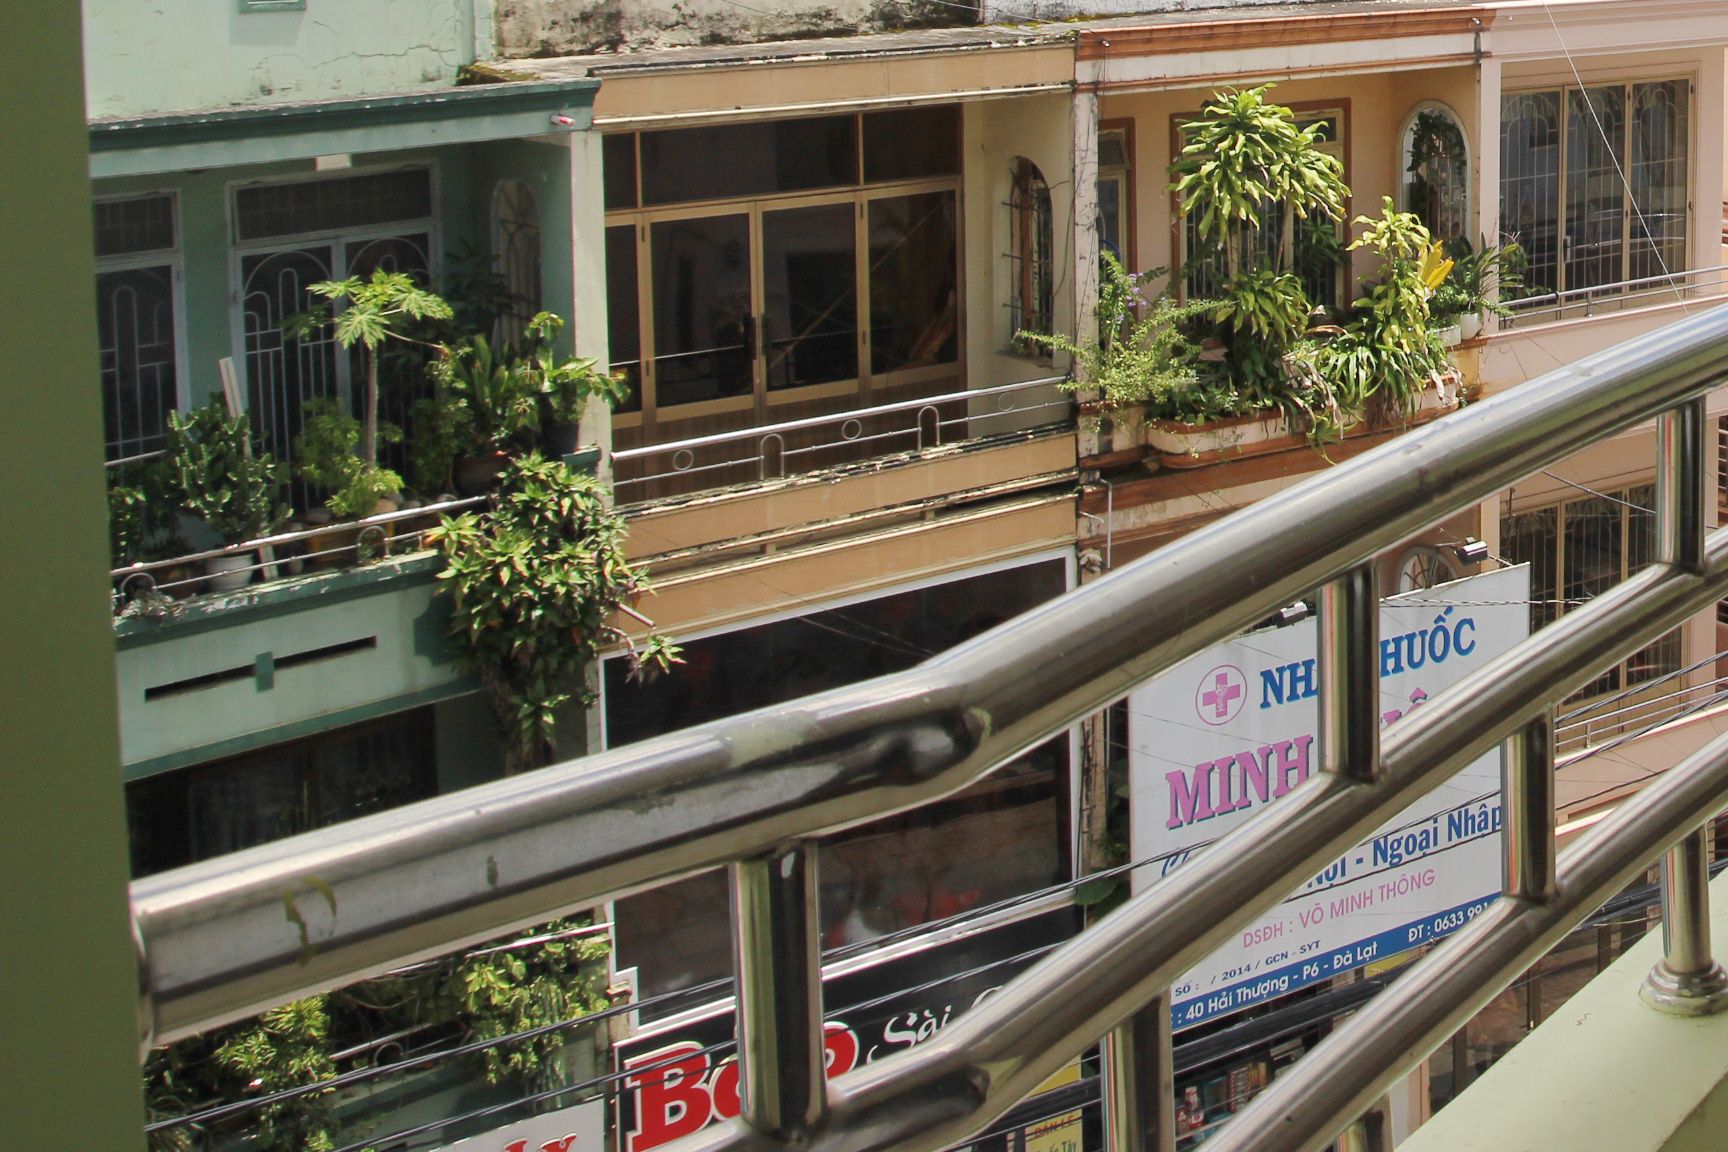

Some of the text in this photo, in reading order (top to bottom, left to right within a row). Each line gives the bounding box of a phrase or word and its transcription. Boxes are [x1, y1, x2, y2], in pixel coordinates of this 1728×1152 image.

[1259, 659, 1318, 709] NH
[1379, 605, 1476, 677] HUỐC
[1164, 734, 1314, 830] MINH
[1373, 817, 1439, 868] Ngoại
[1243, 922, 1284, 949] DSĐH
[1330, 890, 1374, 919] MINH
[1378, 868, 1436, 902] THÔNG
[1408, 924, 1424, 943] ĐT
[1434, 911, 1464, 932] 0633
[1185, 1002, 1204, 1020] 40
[1208, 990, 1233, 1014] Hải
[1236, 974, 1289, 1003] Thượng
[1302, 961, 1320, 980] P6
[1333, 950, 1353, 970] Đà
[1357, 941, 1378, 961] Lạt
[1222, 964, 1251, 982] 2014
[1265, 951, 1289, 966] GCN
[1299, 940, 1321, 955] SYT
